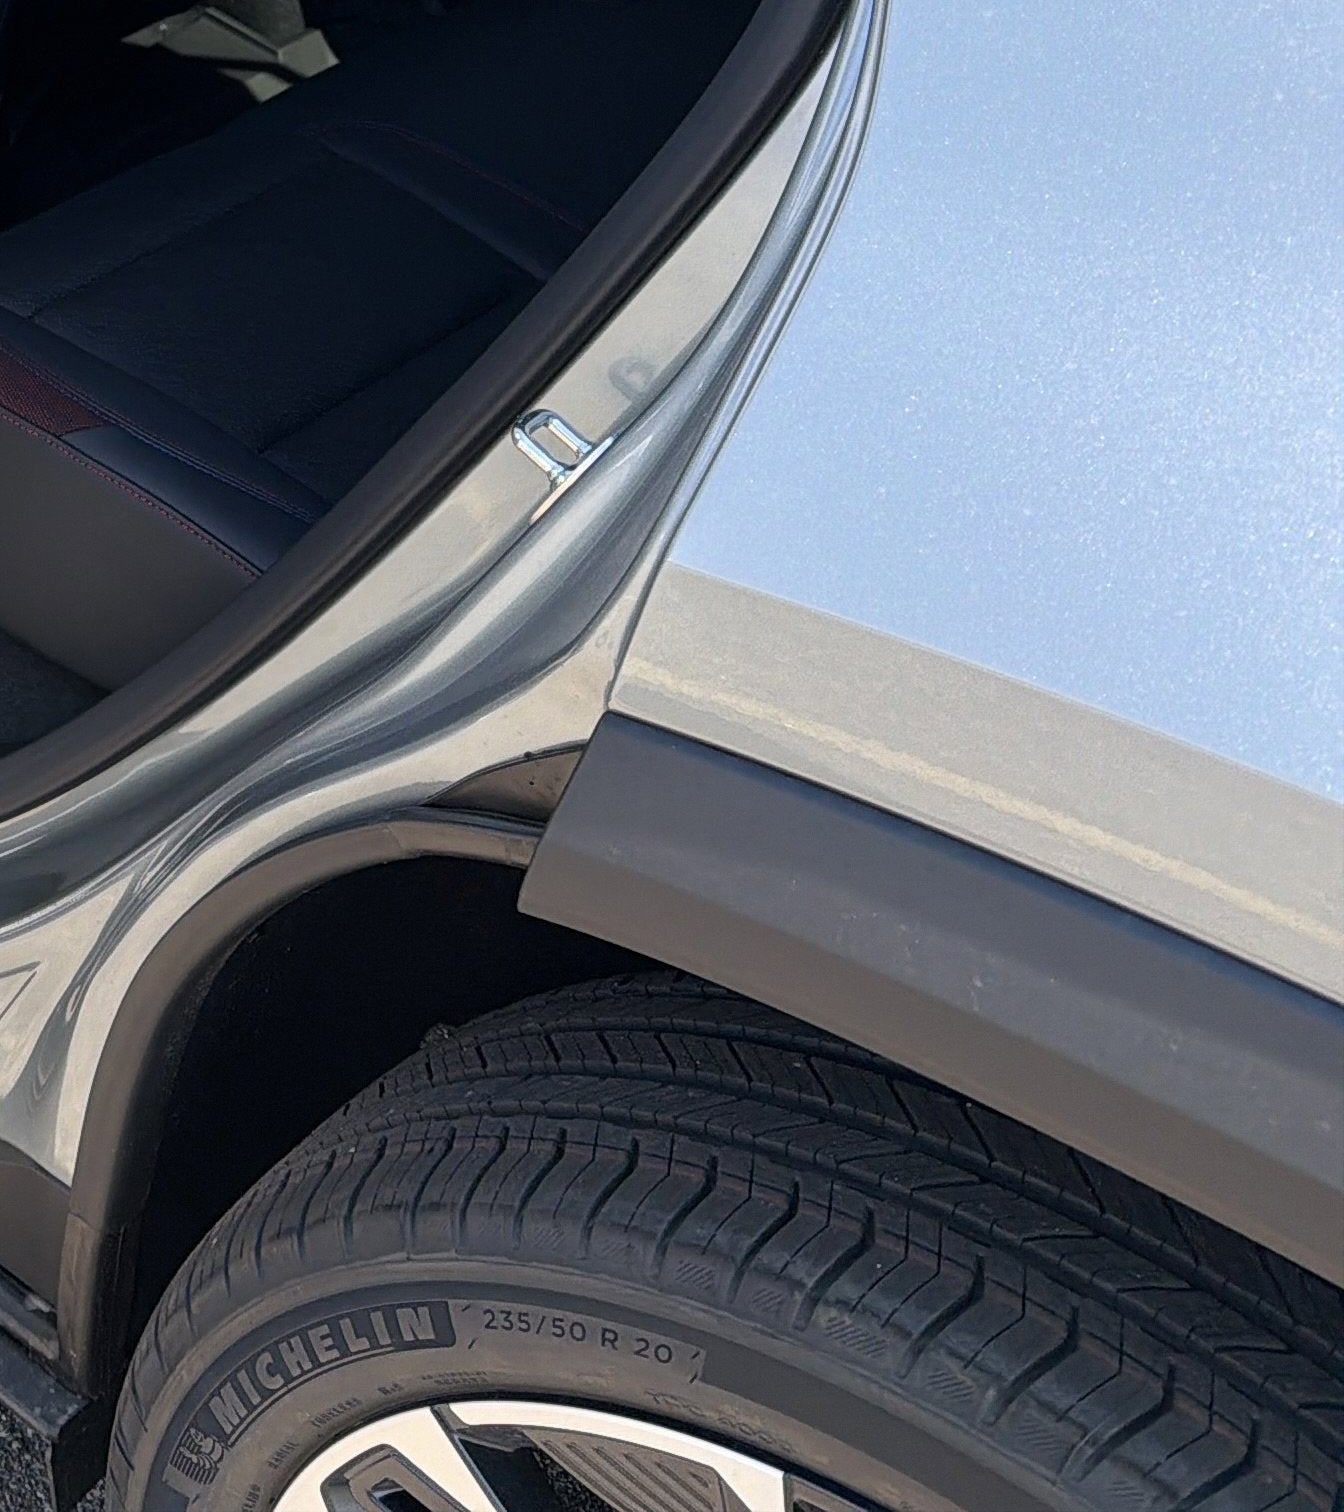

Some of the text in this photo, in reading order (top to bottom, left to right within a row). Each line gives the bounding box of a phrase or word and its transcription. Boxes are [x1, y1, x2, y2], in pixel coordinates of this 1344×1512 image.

[209, 1306, 437, 1435] MICHELIN
[483, 1309, 673, 1364] 235/50 R 20
